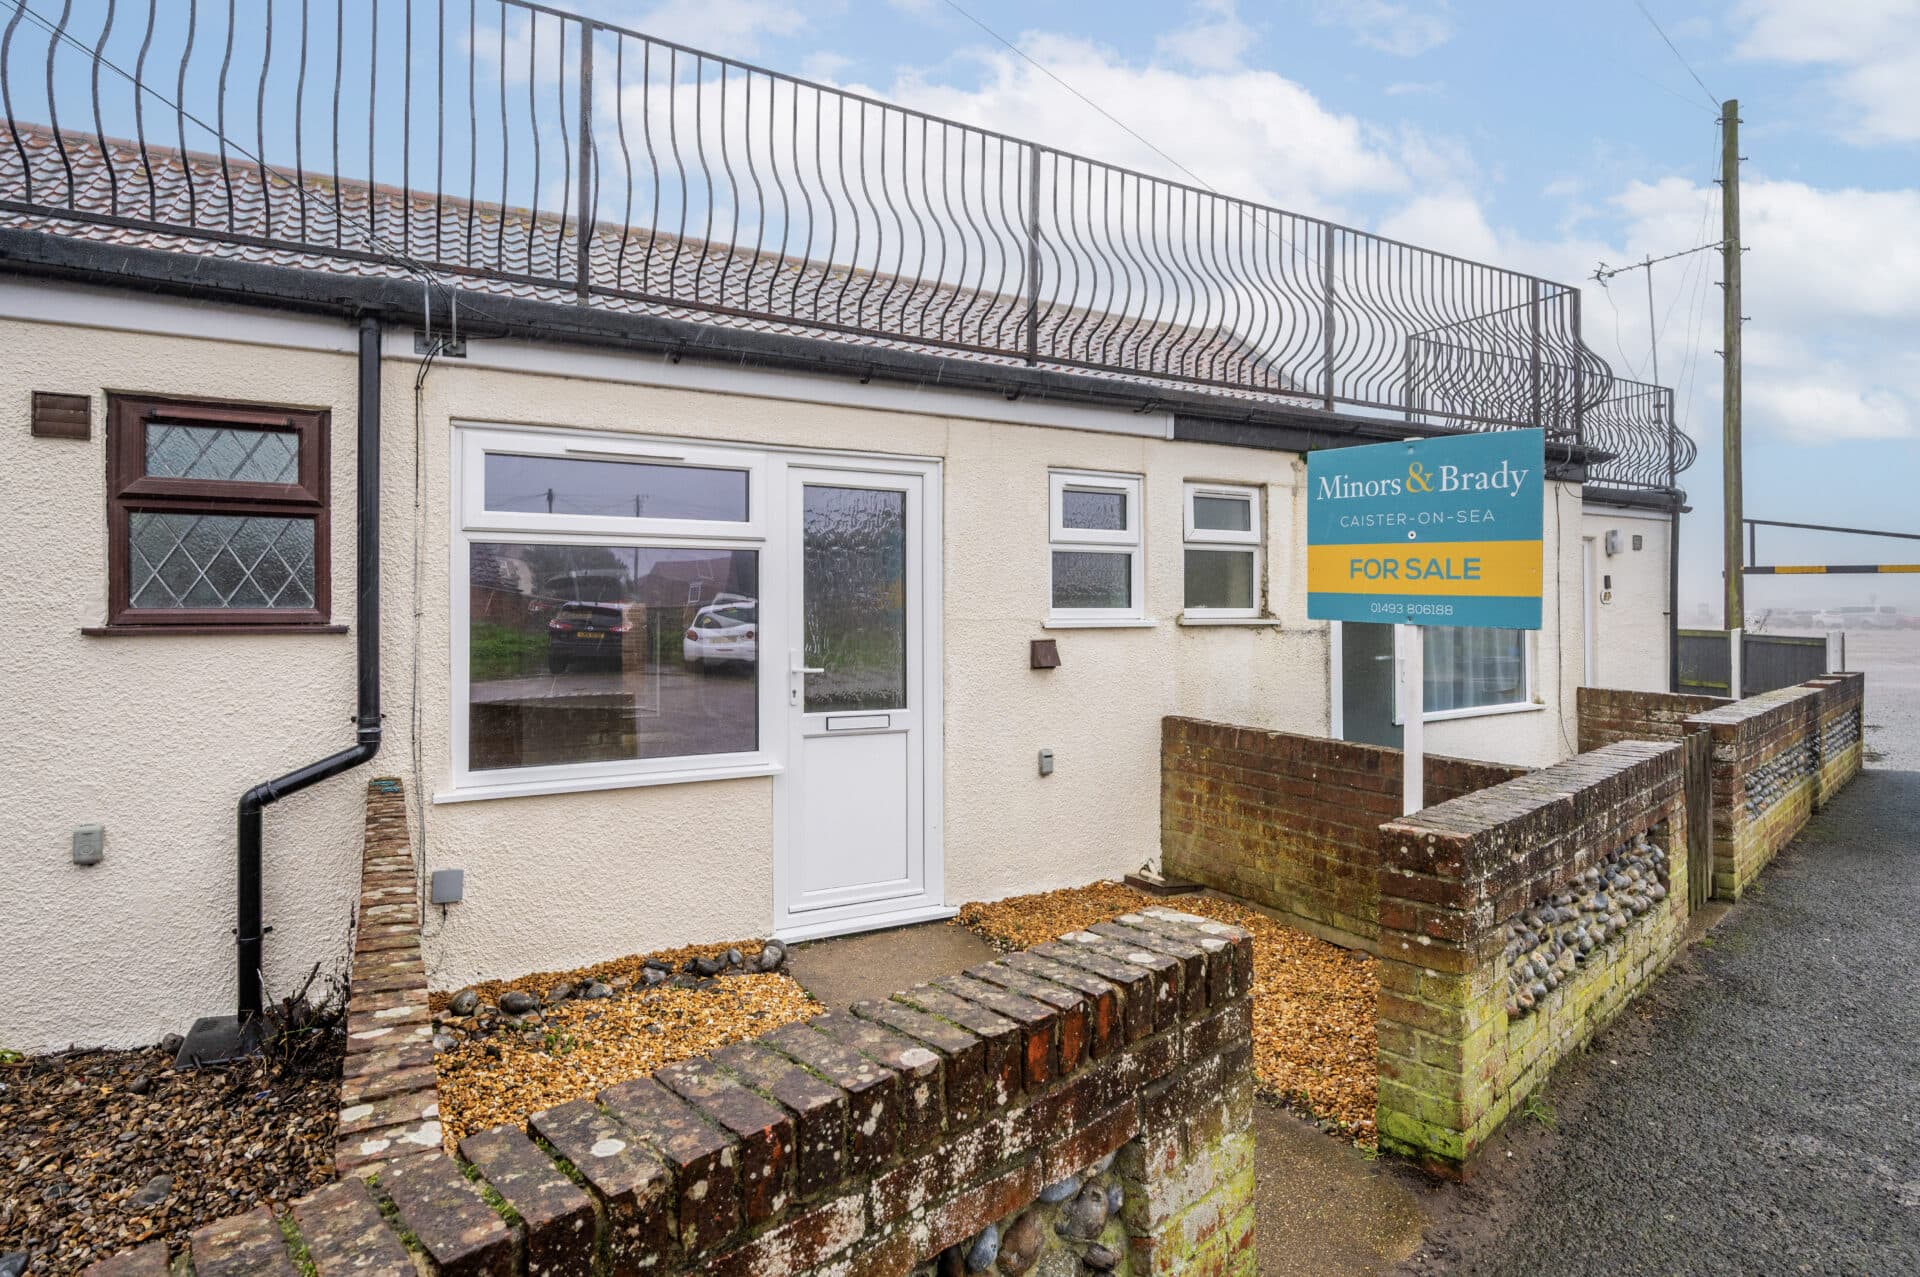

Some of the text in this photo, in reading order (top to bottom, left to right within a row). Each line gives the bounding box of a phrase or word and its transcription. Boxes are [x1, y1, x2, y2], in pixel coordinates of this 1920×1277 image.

[1317, 460, 1529, 500] Minors & Brady
[1340, 509, 1496, 528] CAISTER-ON-SEA
[1350, 558, 1481, 580] FOR SALE
[1370, 602, 1453, 616] 01493 806188
